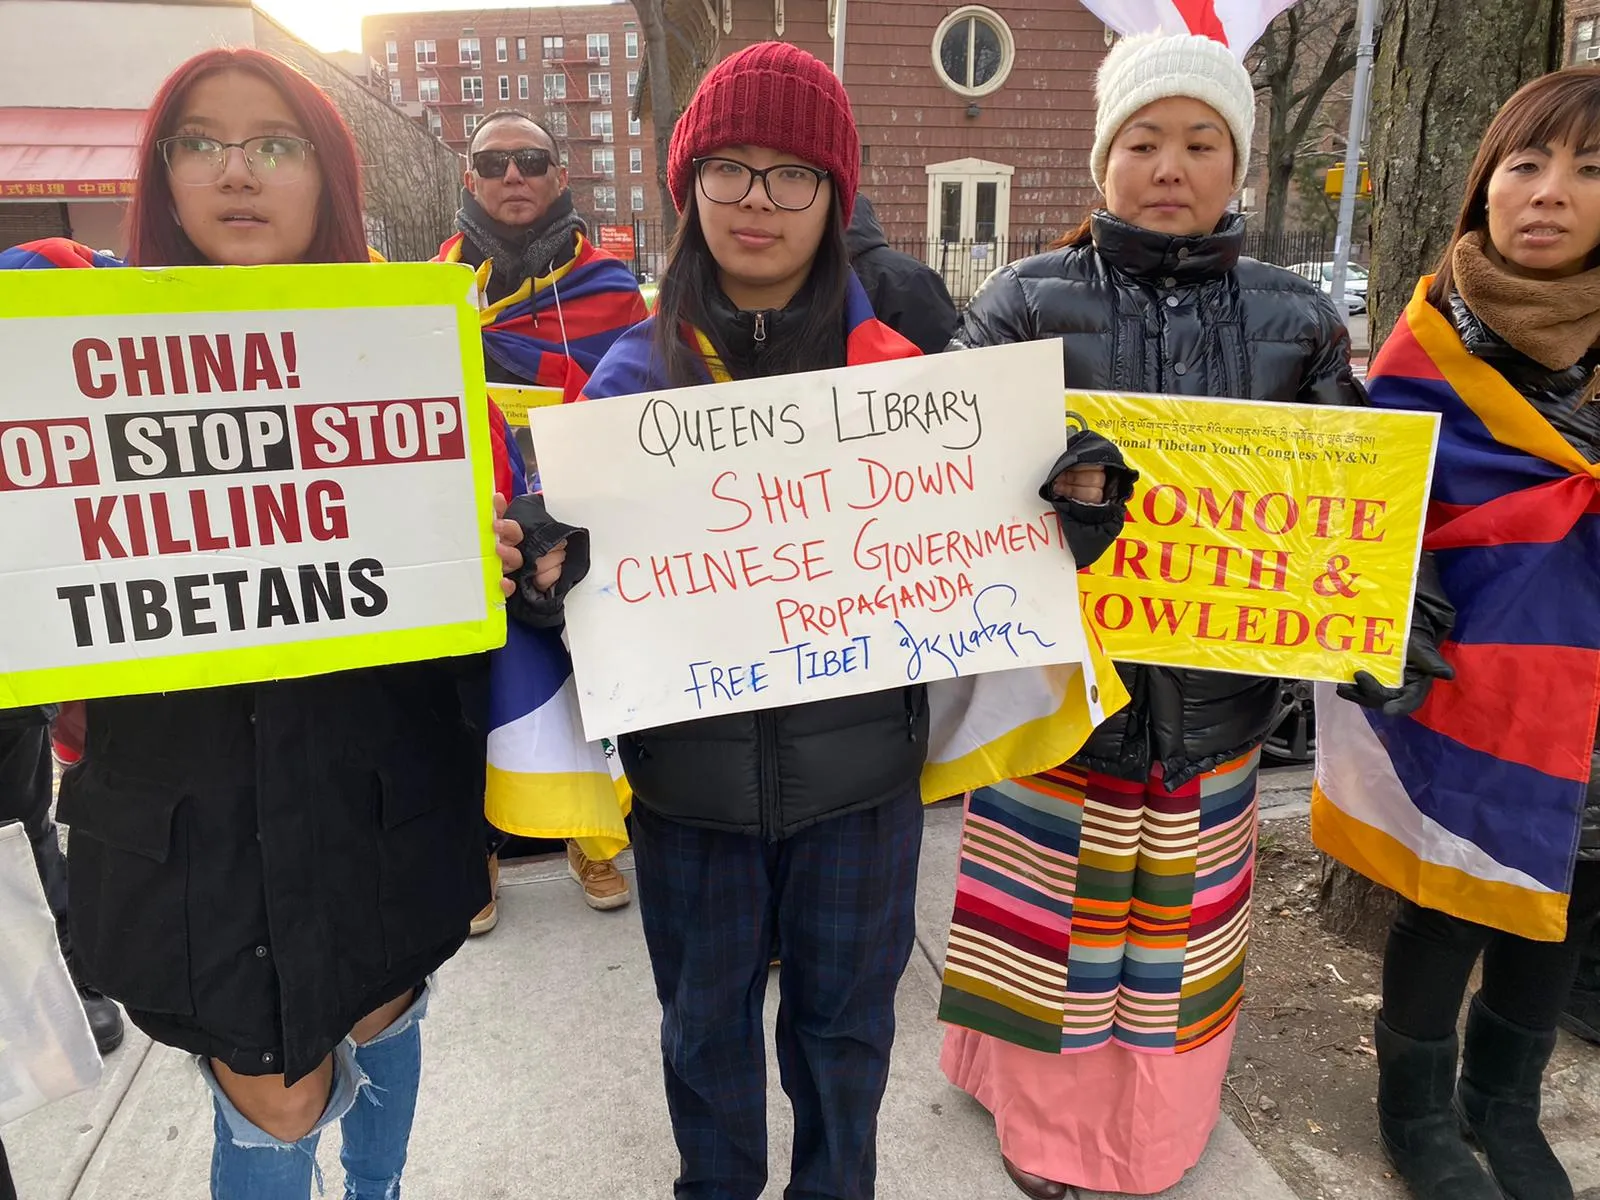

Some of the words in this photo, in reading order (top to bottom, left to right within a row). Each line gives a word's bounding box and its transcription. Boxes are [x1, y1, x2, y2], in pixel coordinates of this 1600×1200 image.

[0, 183, 65, 195] 式料理
[72, 332, 301, 399] CHINA!
[0, 424, 92, 486] OP
[123, 411, 285, 477] STOP
[311, 400, 458, 463] STOP
[506, 411, 528, 419] Tibeta
[638, 397, 805, 466] QUEENS
[831, 387, 983, 450] LIBRARY
[1111, 436, 1151, 450] ional
[1155, 438, 1207, 453] Tibetan
[1211, 441, 1251, 457] Youth
[1256, 445, 1319, 463] Congress
[1322, 449, 1379, 466] NY&NJ
[73, 479, 350, 561] KILLING
[706, 469, 832, 533] SHUT
[847, 455, 974, 510] DOWN
[1124, 483, 1388, 543] OMOTE
[615, 539, 833, 604] CHINESE
[853, 511, 1064, 581] GOVERNMENT
[1077, 537, 1292, 593] RUTH
[1312, 553, 1362, 599] &
[56, 557, 389, 648] TIBETANS
[776, 573, 975, 644] PROPAGANDA
[1080, 590, 1395, 657] OWLEDGE
[684, 660, 769, 709] FREE
[769, 635, 872, 687] TIBET
